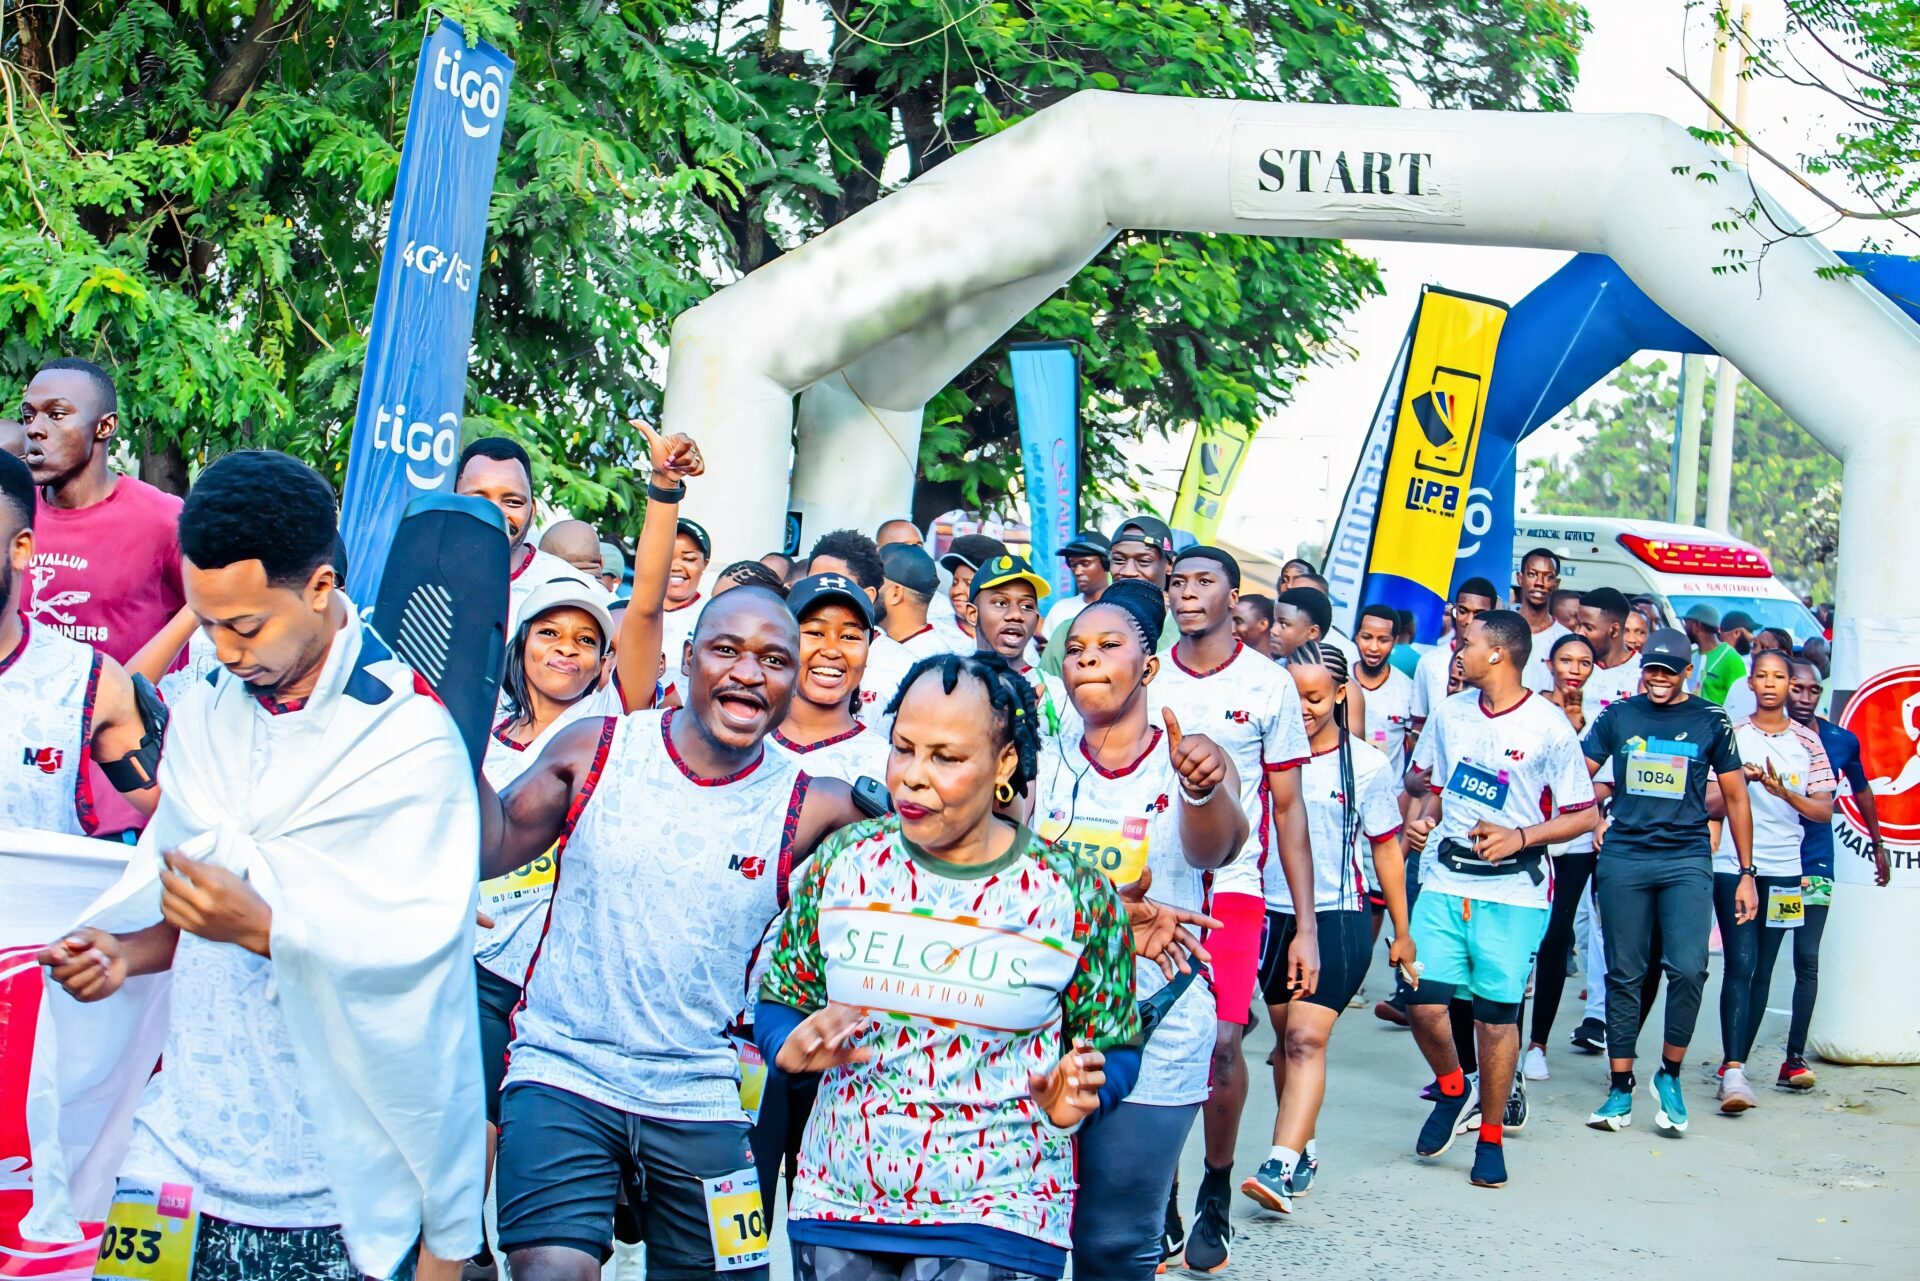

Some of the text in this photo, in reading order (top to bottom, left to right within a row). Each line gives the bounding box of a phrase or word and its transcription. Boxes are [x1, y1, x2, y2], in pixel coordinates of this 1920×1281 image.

[1258, 148, 1432, 196] START
[28, 553, 89, 571] UYALLUP
[45, 624, 109, 642] NNERS
[1460, 774, 1498, 800] 1956
[1637, 770, 1675, 784] 1084
[1834, 821, 1920, 869] MARTH
[839, 927, 1028, 988] SELOUS
[862, 975, 986, 1009] MARATHON
[733, 1209, 763, 1240] 10
